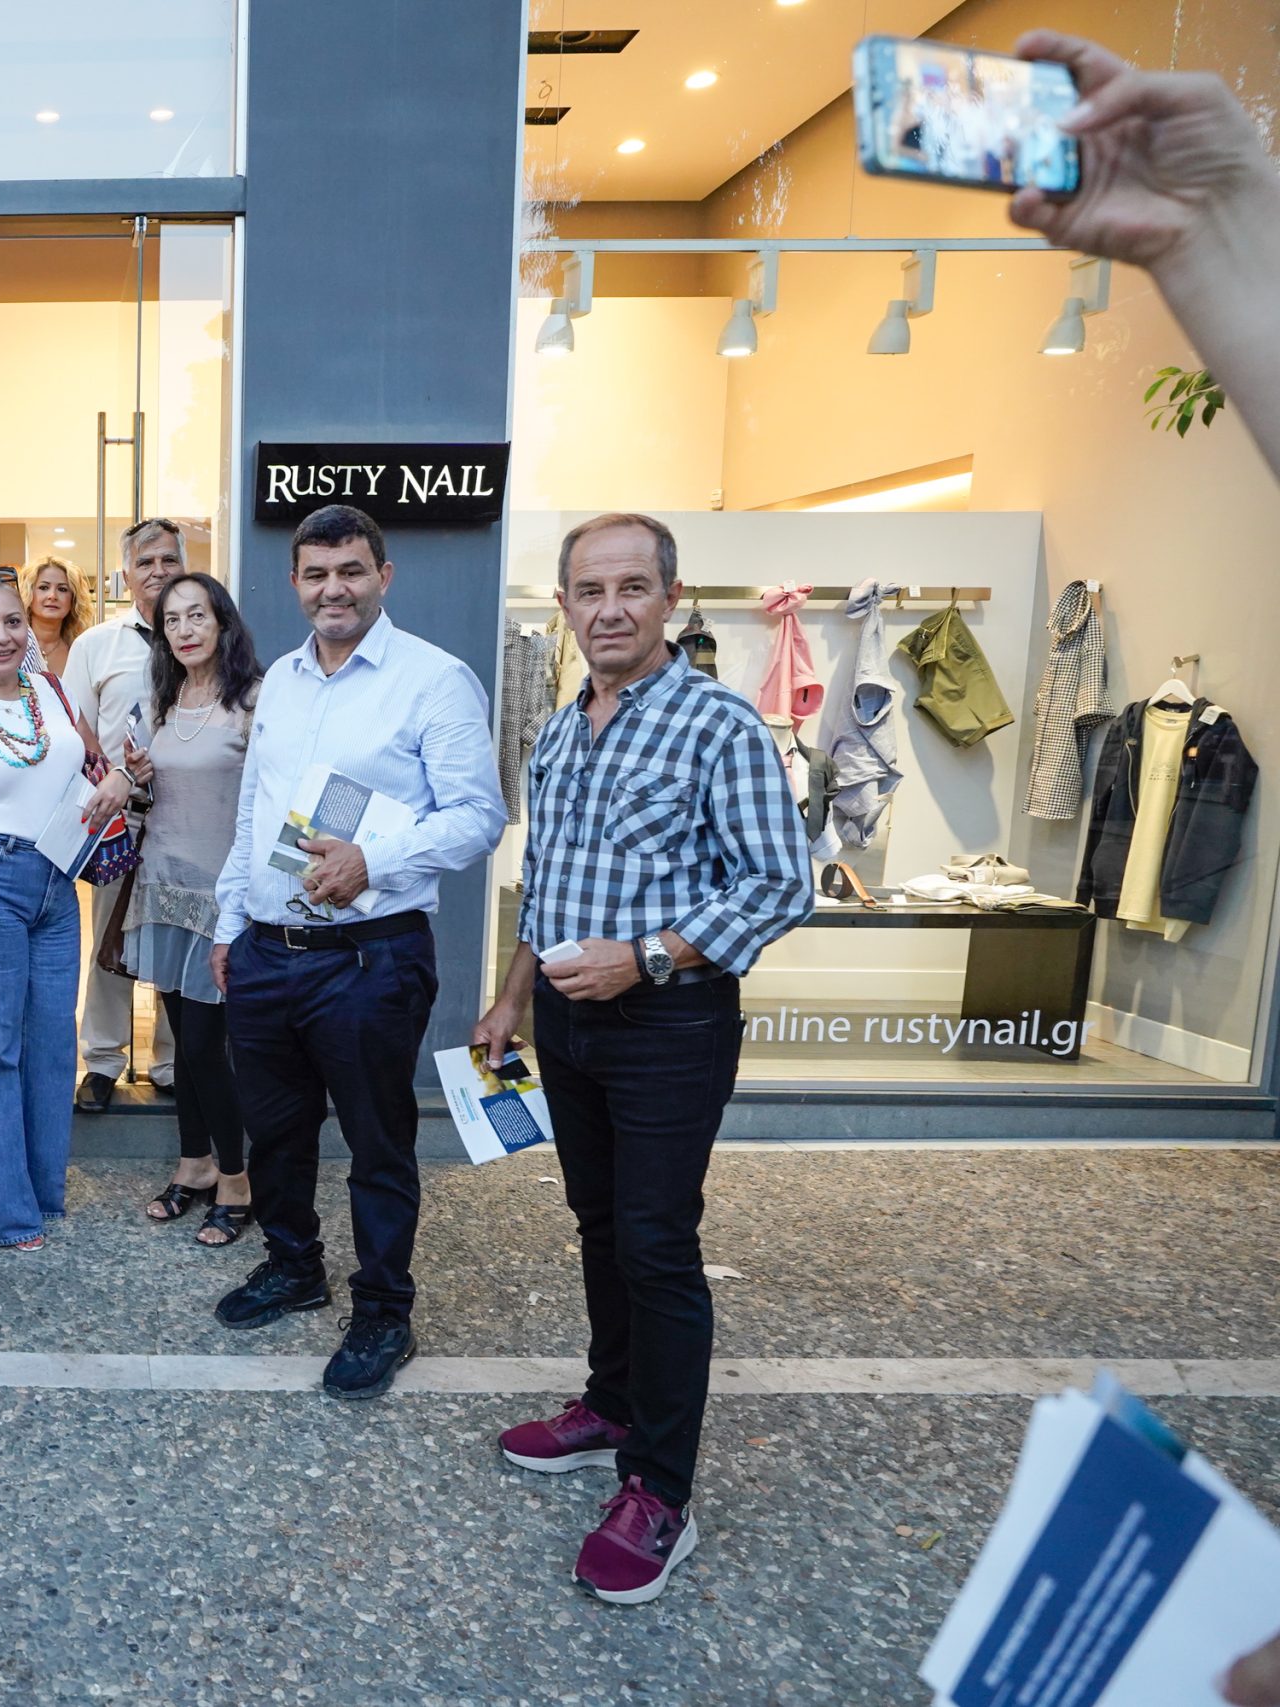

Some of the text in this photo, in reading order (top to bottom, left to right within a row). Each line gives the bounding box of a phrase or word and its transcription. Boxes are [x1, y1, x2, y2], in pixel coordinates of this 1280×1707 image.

[265, 464, 494, 504] RUSTY NAIL
[742, 1006, 1097, 1056] nline rustynail.gr
